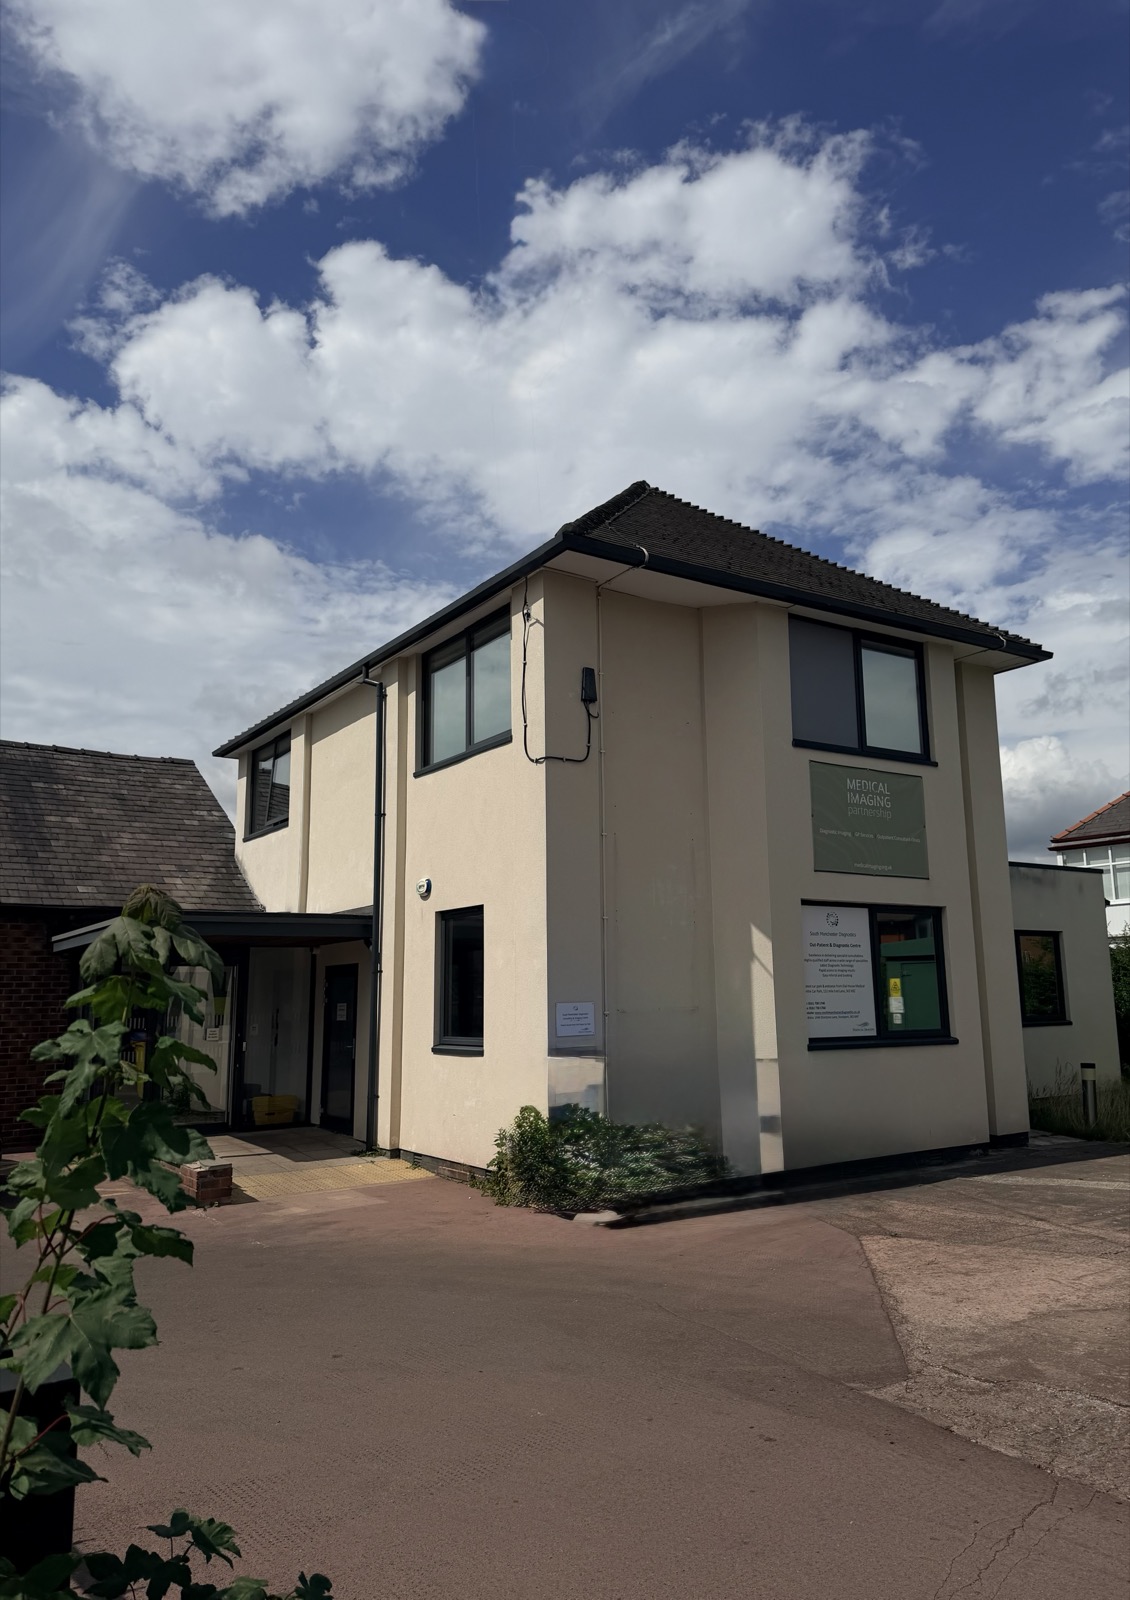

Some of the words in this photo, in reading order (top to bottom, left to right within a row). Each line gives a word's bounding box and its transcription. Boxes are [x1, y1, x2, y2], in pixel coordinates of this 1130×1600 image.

[847, 778, 890, 795] MEDICAL
[847, 792, 891, 808] IMAGING
[848, 806, 892, 821] partnership
